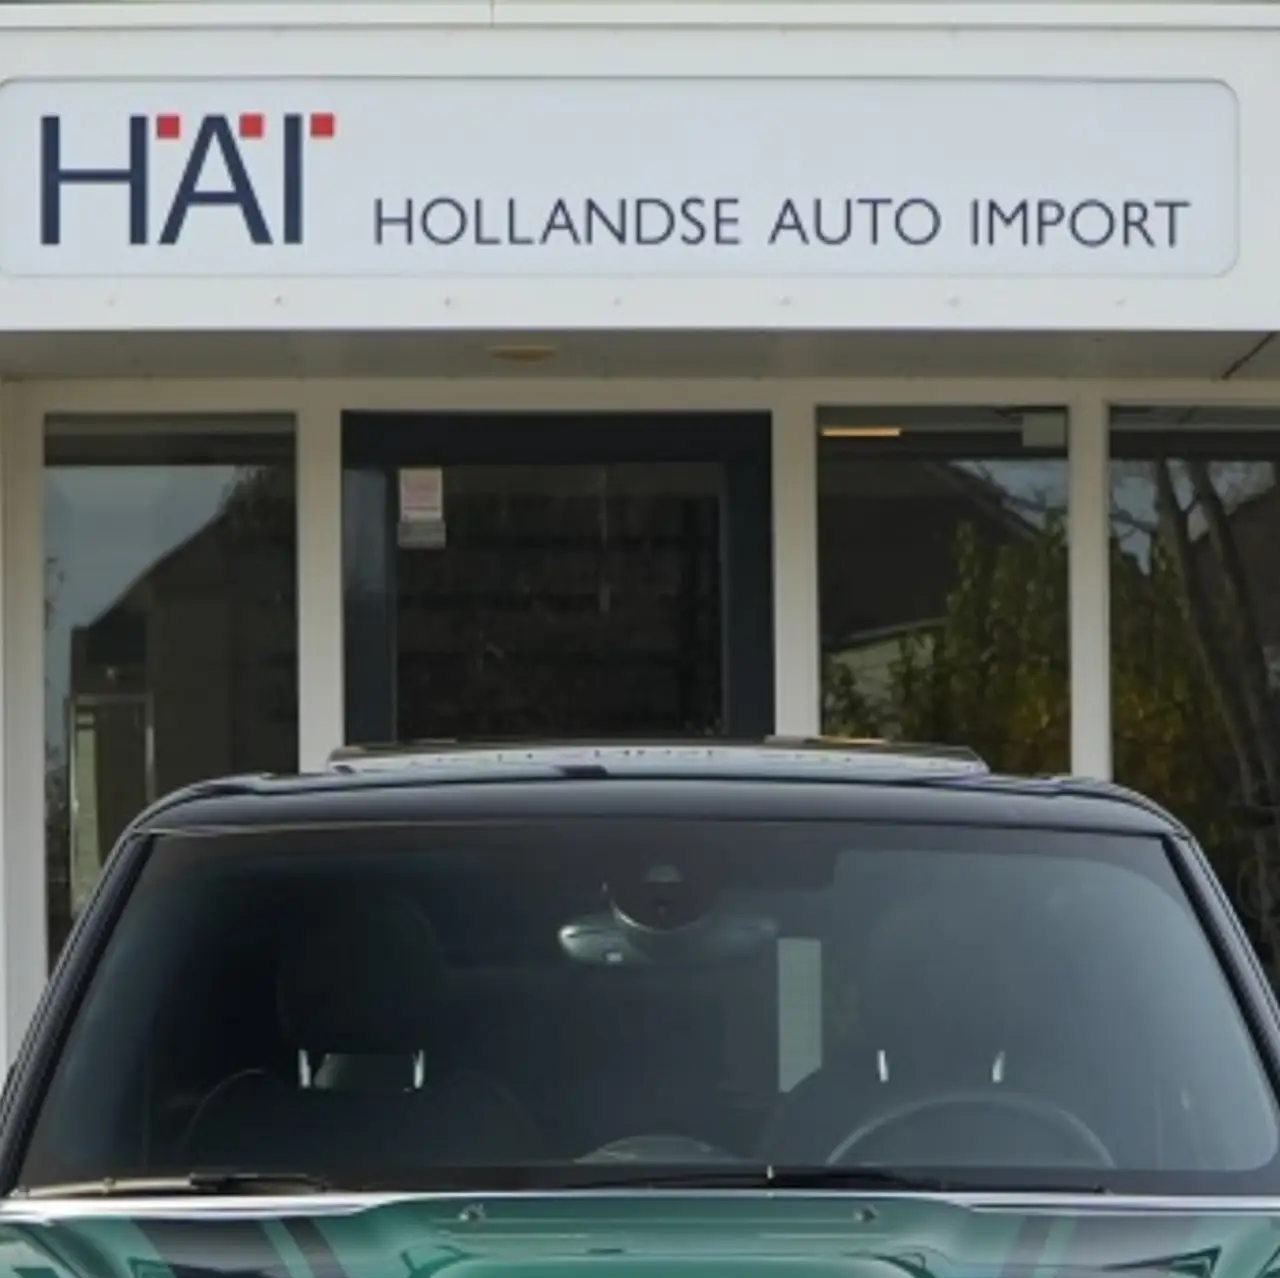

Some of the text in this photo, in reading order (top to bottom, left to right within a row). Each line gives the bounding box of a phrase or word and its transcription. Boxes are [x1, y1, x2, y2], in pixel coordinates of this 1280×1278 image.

[374, 197, 1192, 248] HOLLANDSE AUTO IMPORT
